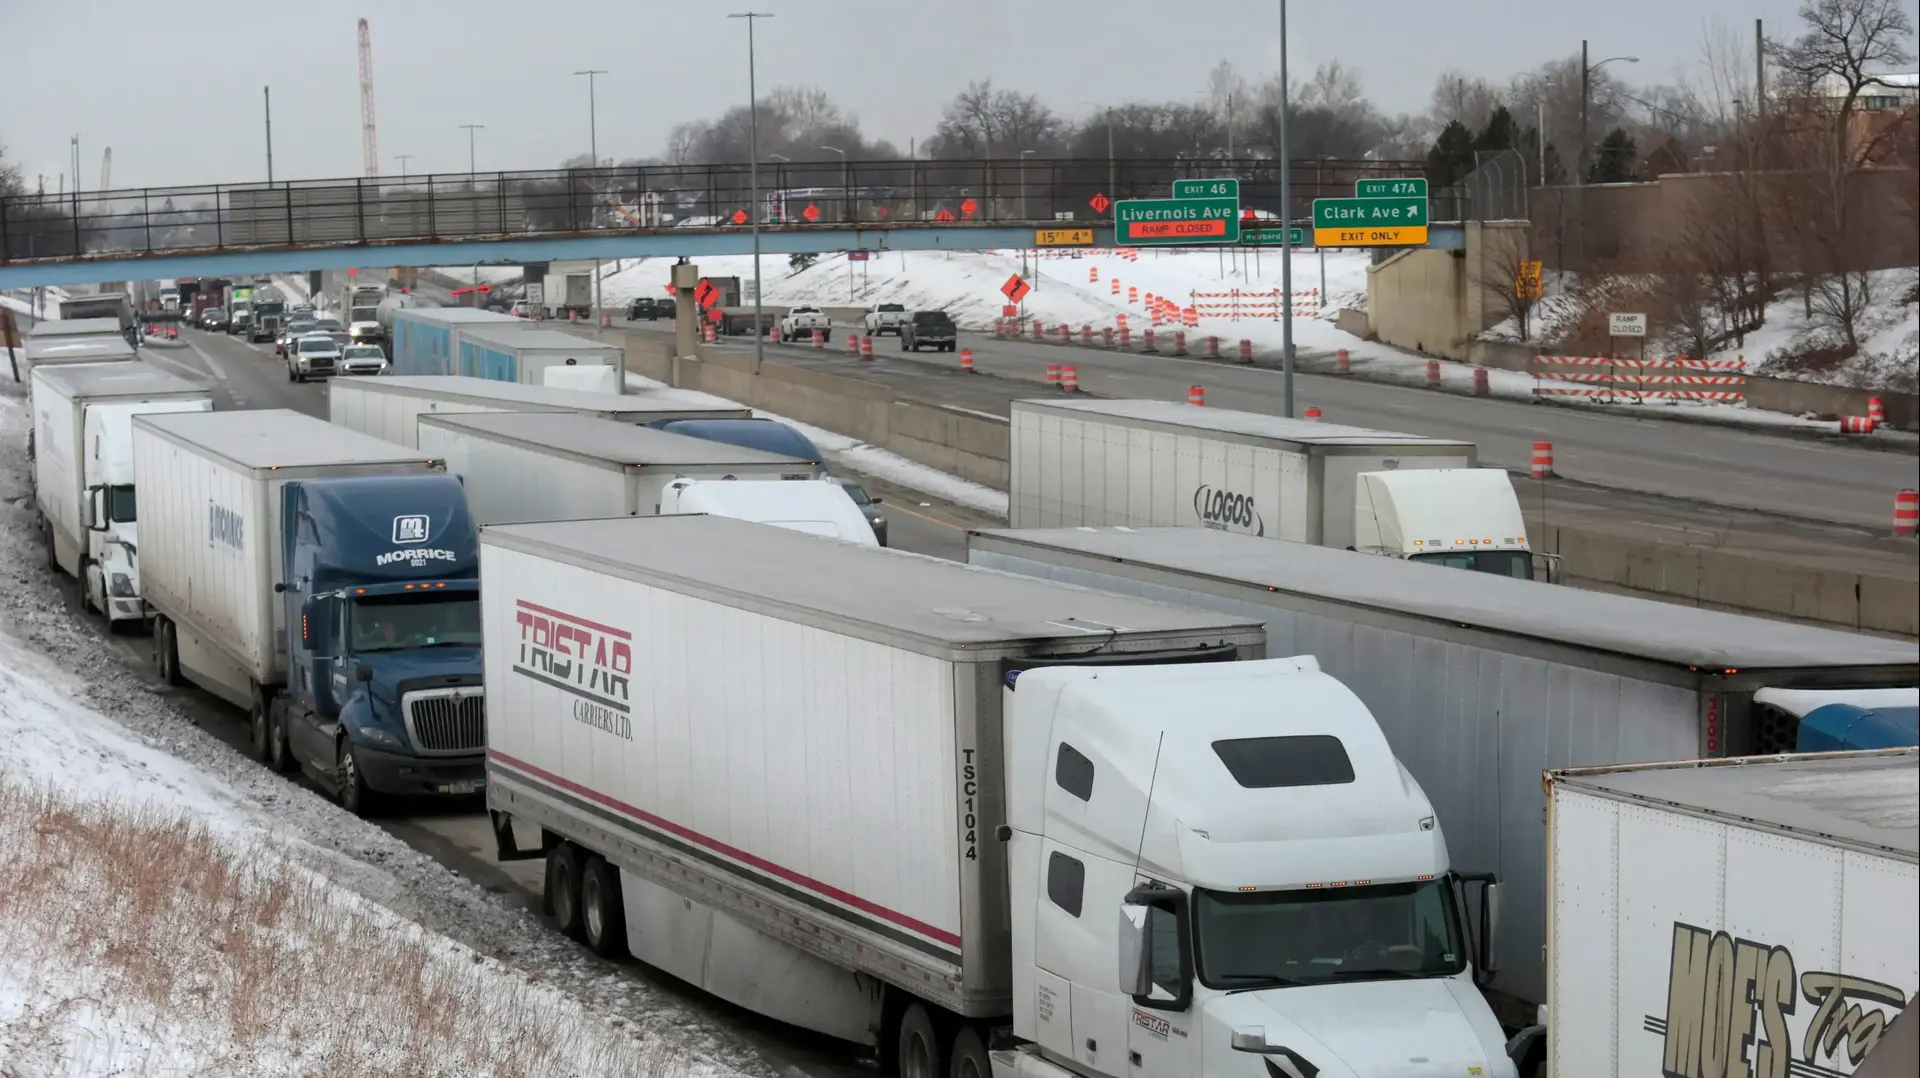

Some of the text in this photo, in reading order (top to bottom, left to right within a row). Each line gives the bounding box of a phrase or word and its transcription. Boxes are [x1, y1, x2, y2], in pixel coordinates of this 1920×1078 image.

[1184, 184, 1227, 194] EXIT 46
[1366, 183, 1416, 193] EXIT 47A
[1122, 207, 1232, 221] Livernois Ave
[1324, 207, 1400, 219] Clark Ave
[1142, 224, 1213, 234] RAMP CLOSED
[1341, 231, 1400, 241] EXIT ONLY
[1042, 232, 1055, 243] 15
[1072, 232, 1080, 242] 4
[1612, 325, 1643, 333] CLOSED
[1203, 488, 1255, 528] LOGOS
[376, 548, 456, 566] MORRICE
[516, 610, 632, 701] TRISTAR
[573, 699, 633, 742] CARRIERS LTD.
[962, 748, 977, 861] TSC1044
[1132, 1010, 1170, 1035] TRISTAR
[1800, 971, 1907, 1067] Tra
